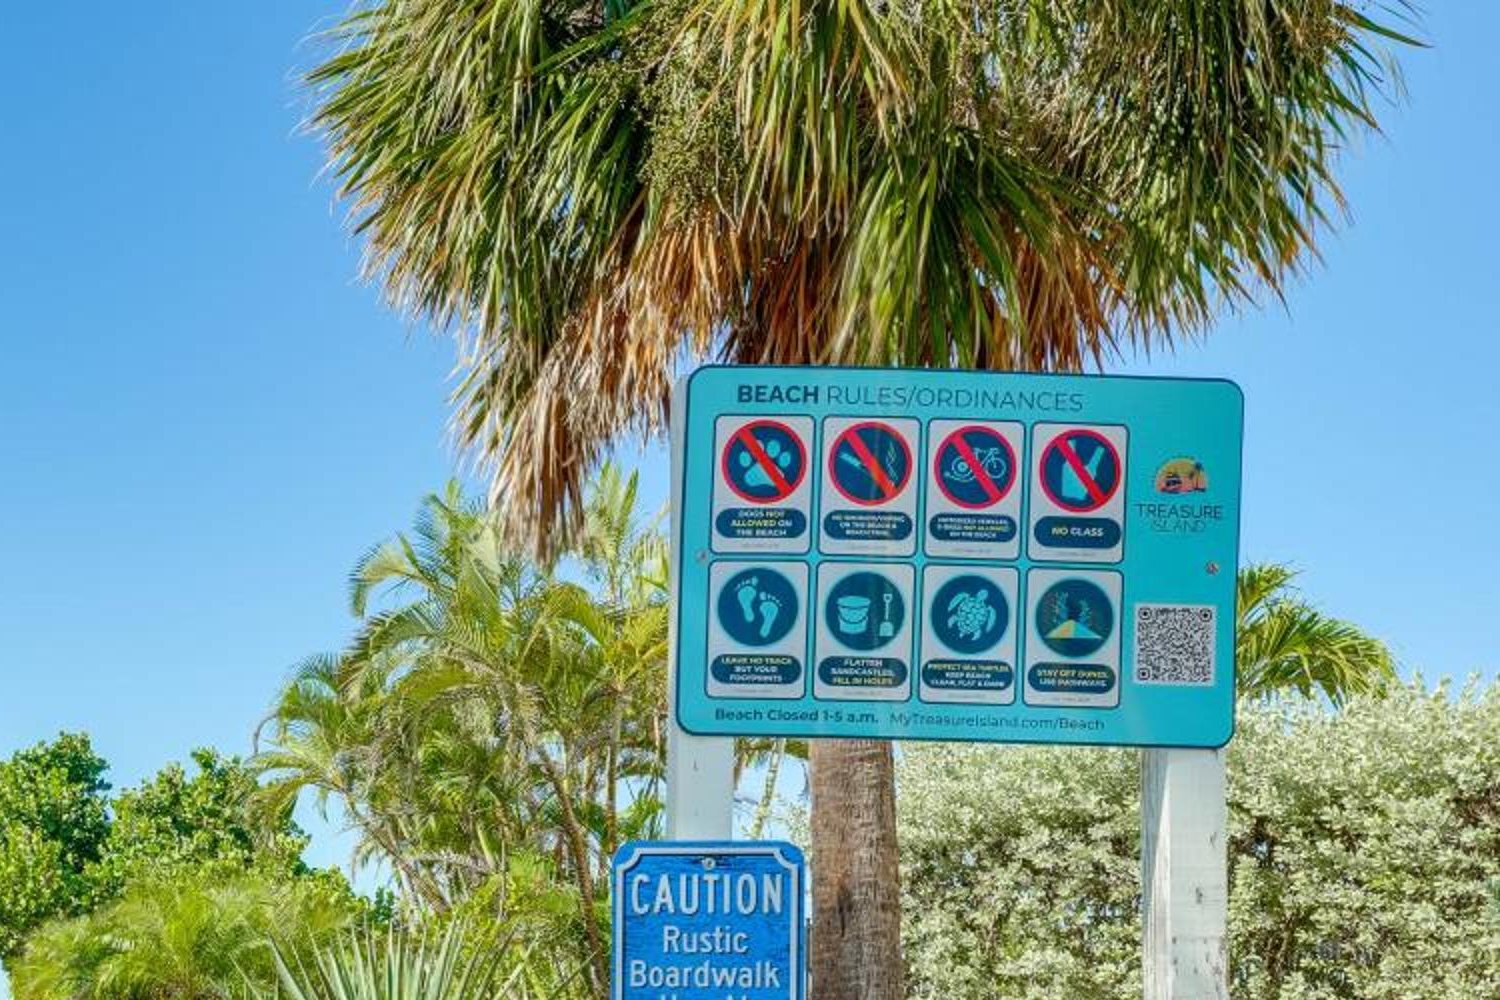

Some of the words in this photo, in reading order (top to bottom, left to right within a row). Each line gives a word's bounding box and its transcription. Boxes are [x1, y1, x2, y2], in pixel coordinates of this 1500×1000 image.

[737, 384, 819, 405] BEACH
[826, 385, 1084, 413] RULES/ORDINANCES
[765, 511, 786, 519] NOT
[1134, 503, 1223, 520] TREASURE
[730, 519, 777, 527] ALLOWED
[777, 519, 793, 527] ON
[1150, 519, 1206, 534] ISLAND
[736, 529, 754, 537] THE
[755, 529, 787, 537] BEACH
[1051, 526, 1069, 536] NO
[1069, 526, 1104, 537] GLASS
[721, 657, 748, 665] LEAVE
[749, 657, 763, 665] NO
[843, 659, 883, 667] FLATTEN
[733, 665, 753, 673] BUT
[754, 665, 779, 673] YOUR
[1036, 669, 1058, 677] STAY
[833, 676, 850, 685] FILL
[715, 708, 763, 721] Beach
[767, 709, 818, 721] Closed
[822, 710, 842, 722] 1-5
[847, 712, 879, 724] a.m.
[889, 712, 1105, 731] MyTreasureIsland.com/Beach
[630, 873, 783, 915] CAUTION
[662, 925, 749, 953] Rustic
[629, 960, 781, 988] Boardwalk
